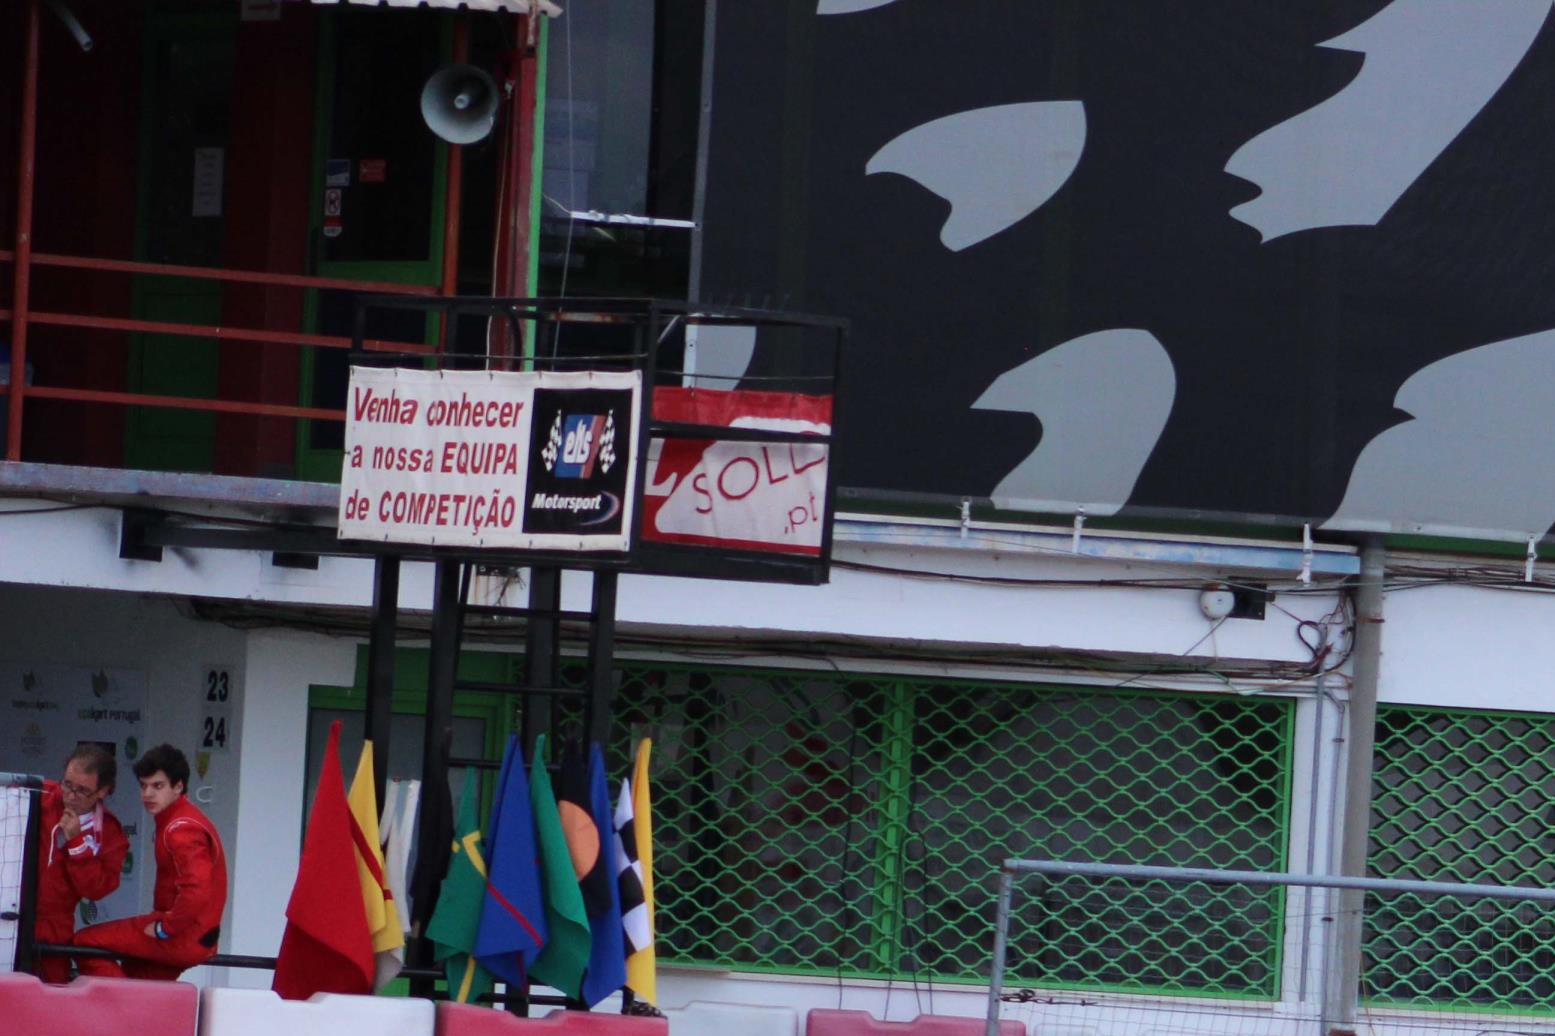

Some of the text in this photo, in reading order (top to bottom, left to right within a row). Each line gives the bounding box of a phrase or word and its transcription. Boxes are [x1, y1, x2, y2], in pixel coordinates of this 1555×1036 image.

[354, 386, 524, 428] Venha conhecer
[351, 441, 517, 476] a nossa EQUIPA
[345, 488, 516, 536] de COMPETIÇÃO
[531, 493, 602, 513] Motorsport
[207, 670, 229, 702] 23
[203, 716, 227, 748] 24
